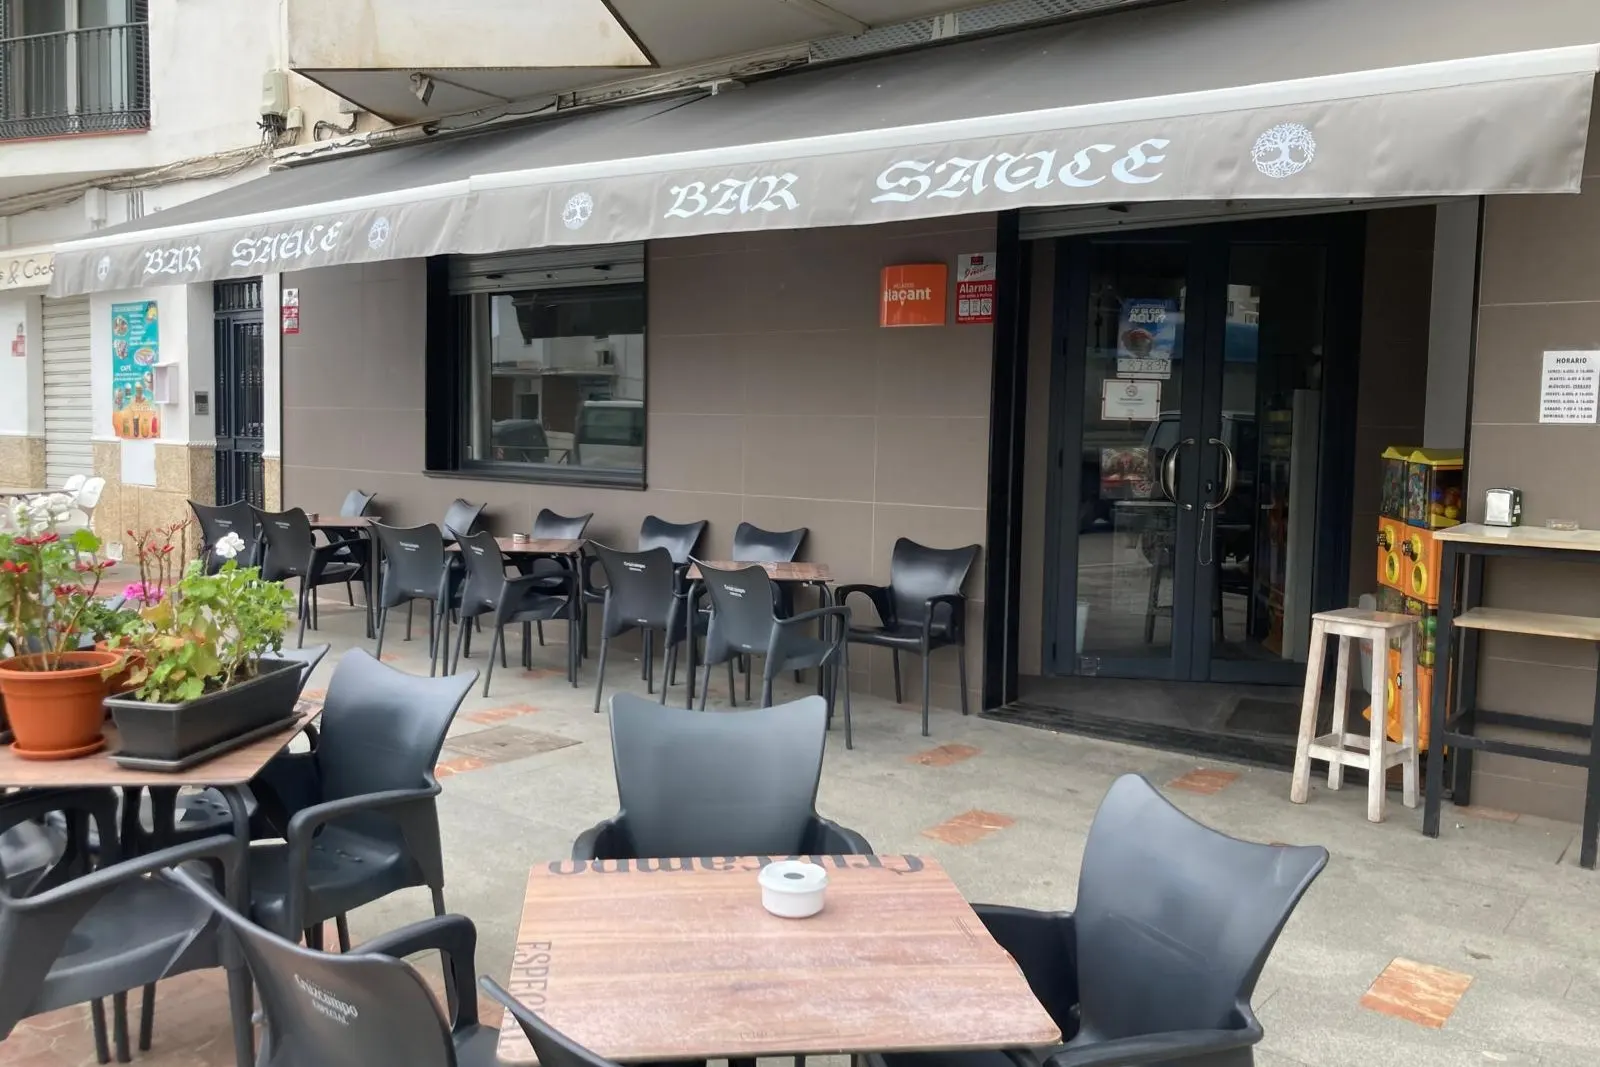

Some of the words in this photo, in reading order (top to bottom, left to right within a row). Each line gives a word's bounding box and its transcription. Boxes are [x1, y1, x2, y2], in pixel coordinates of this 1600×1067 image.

[663, 172, 800, 219] BAR
[870, 138, 1170, 204] SAUCE
[143, 245, 202, 275] BAR
[230, 221, 344, 267] SAUCE
[959, 283, 993, 294] Alarma
